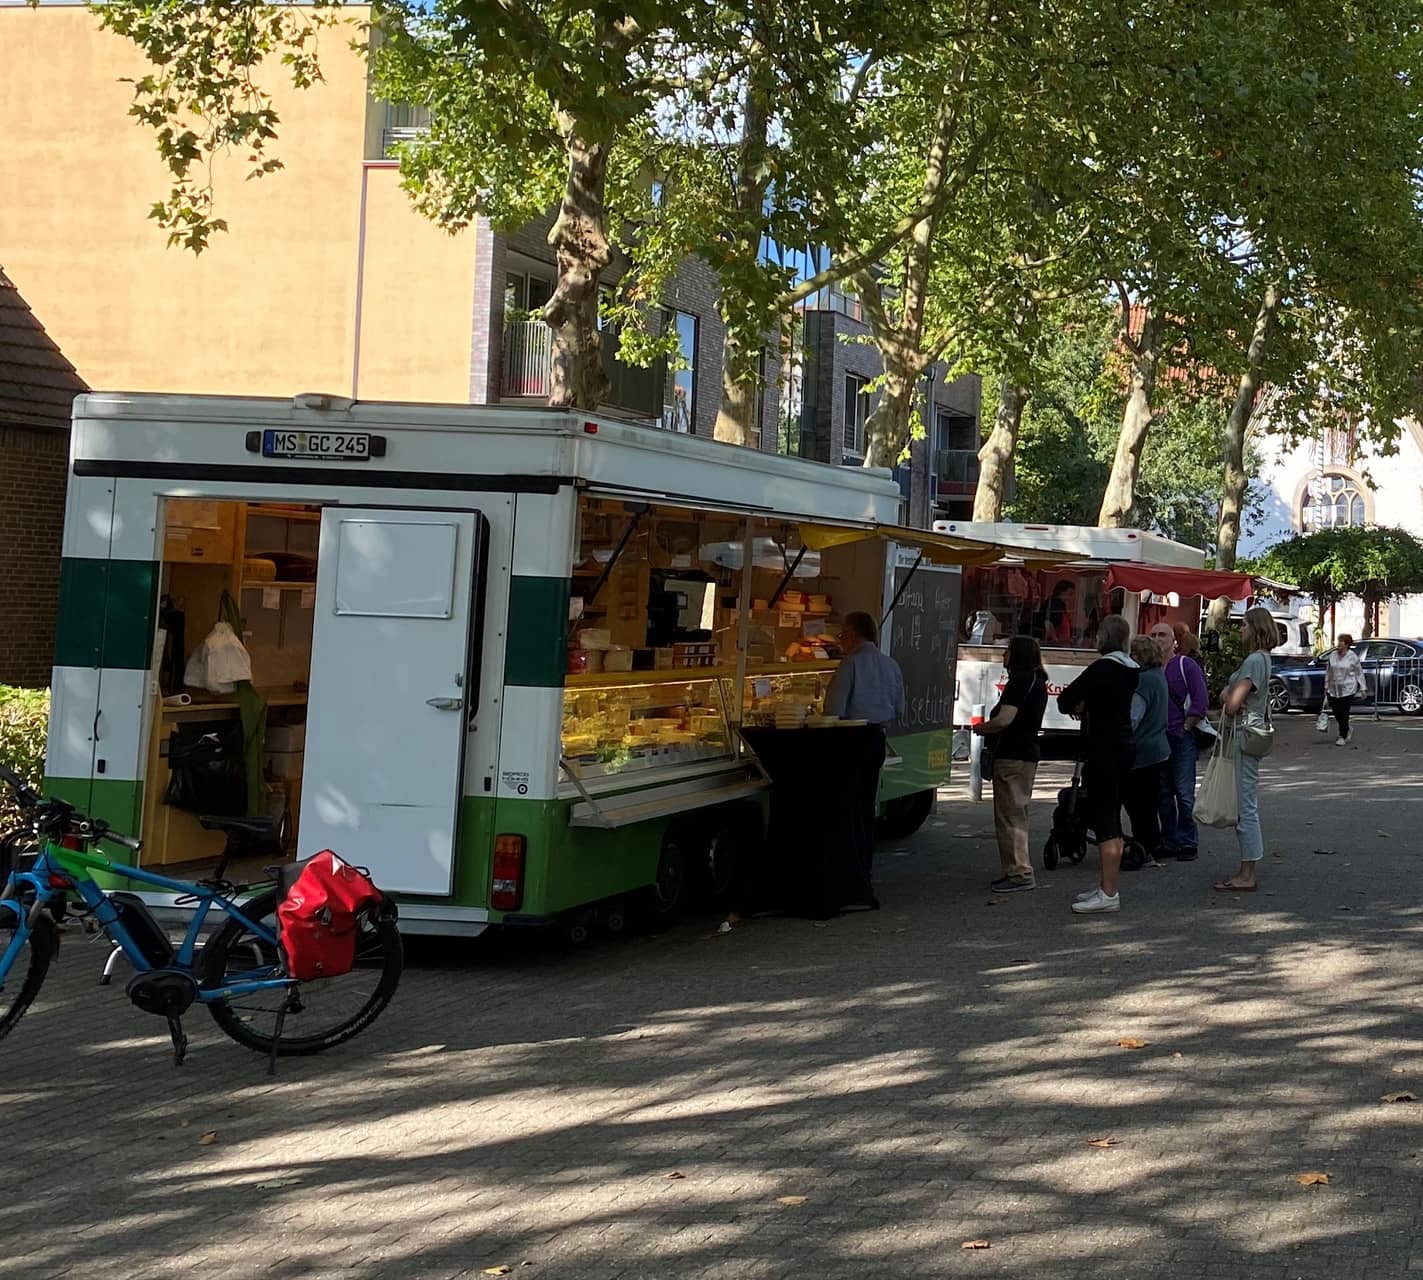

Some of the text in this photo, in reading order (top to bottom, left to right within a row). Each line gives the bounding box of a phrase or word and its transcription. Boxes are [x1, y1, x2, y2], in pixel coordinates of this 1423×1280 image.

[274, 434, 367, 454] MS GC 245
